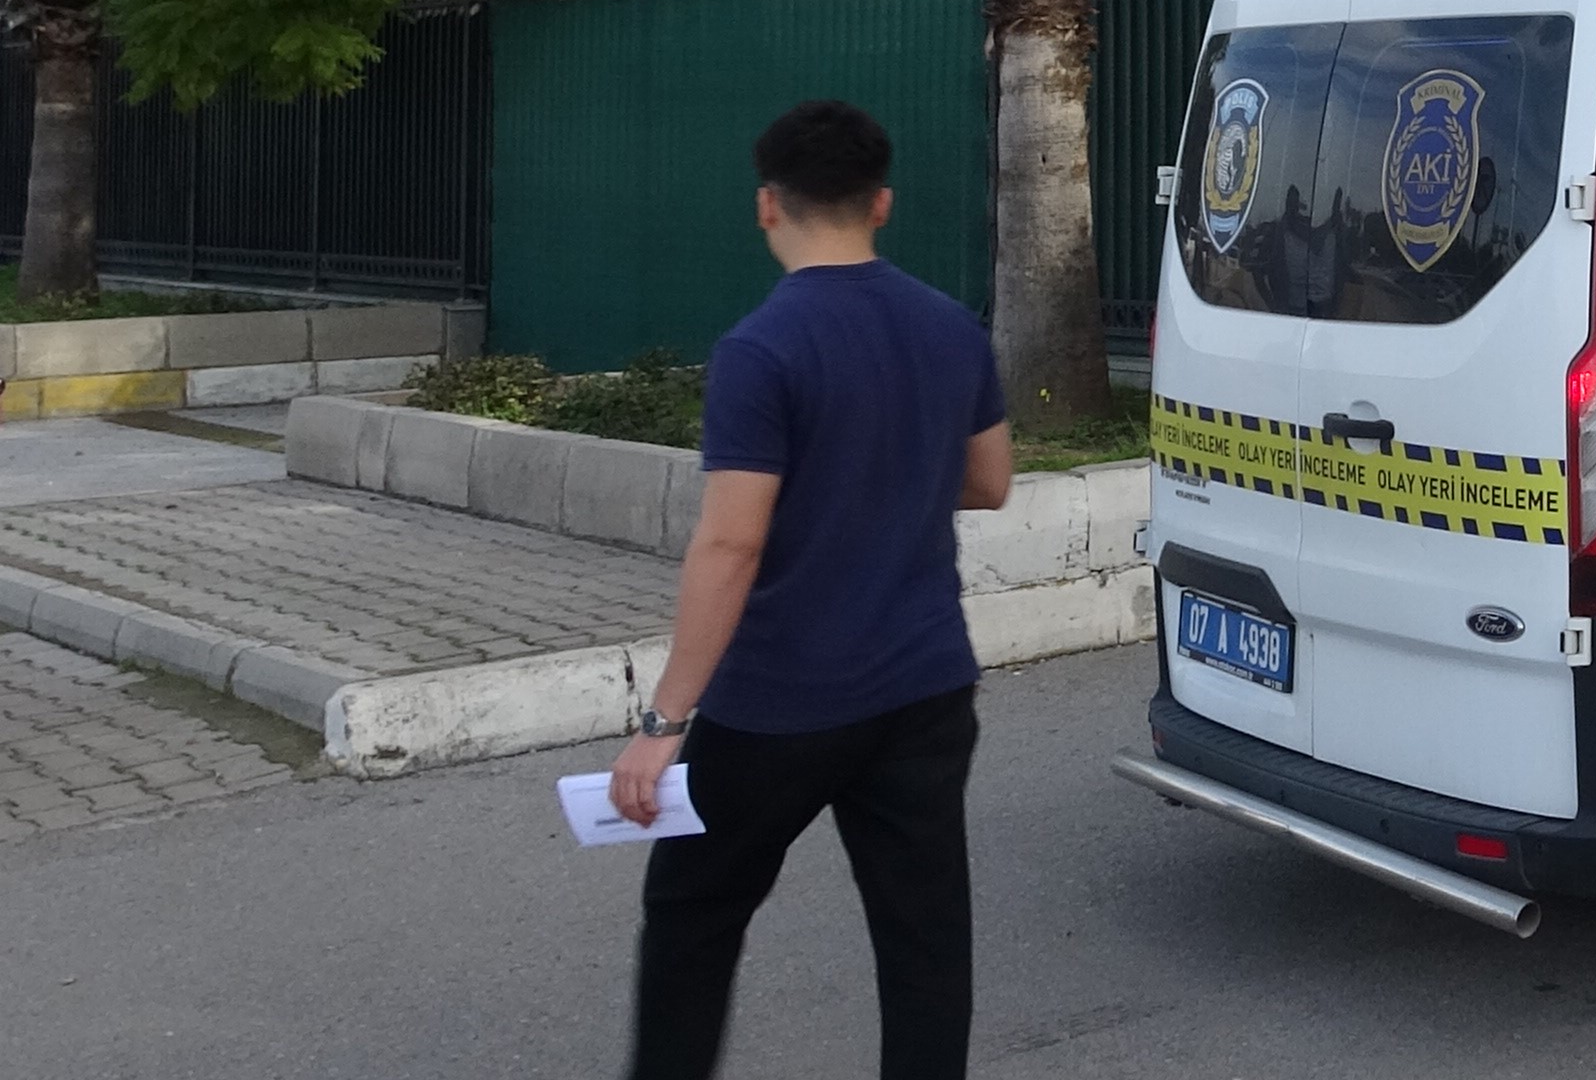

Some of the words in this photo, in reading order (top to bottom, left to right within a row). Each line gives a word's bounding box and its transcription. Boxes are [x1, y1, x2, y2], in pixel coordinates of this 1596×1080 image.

[1404, 148, 1452, 182] AKİ
[1182, 424, 1231, 457] İNCELEME
[1238, 441, 1268, 465] OLAY
[1299, 448, 1366, 486] İNCELEME
[1377, 469, 1415, 493] OLAY
[1421, 471, 1455, 501] YERİ
[1460, 476, 1559, 513] İNCELEME
[1189, 603, 1209, 645] 07
[1217, 613, 1228, 654] A
[1239, 620, 1281, 672] 4938
[1475, 614, 1507, 634] Ford
